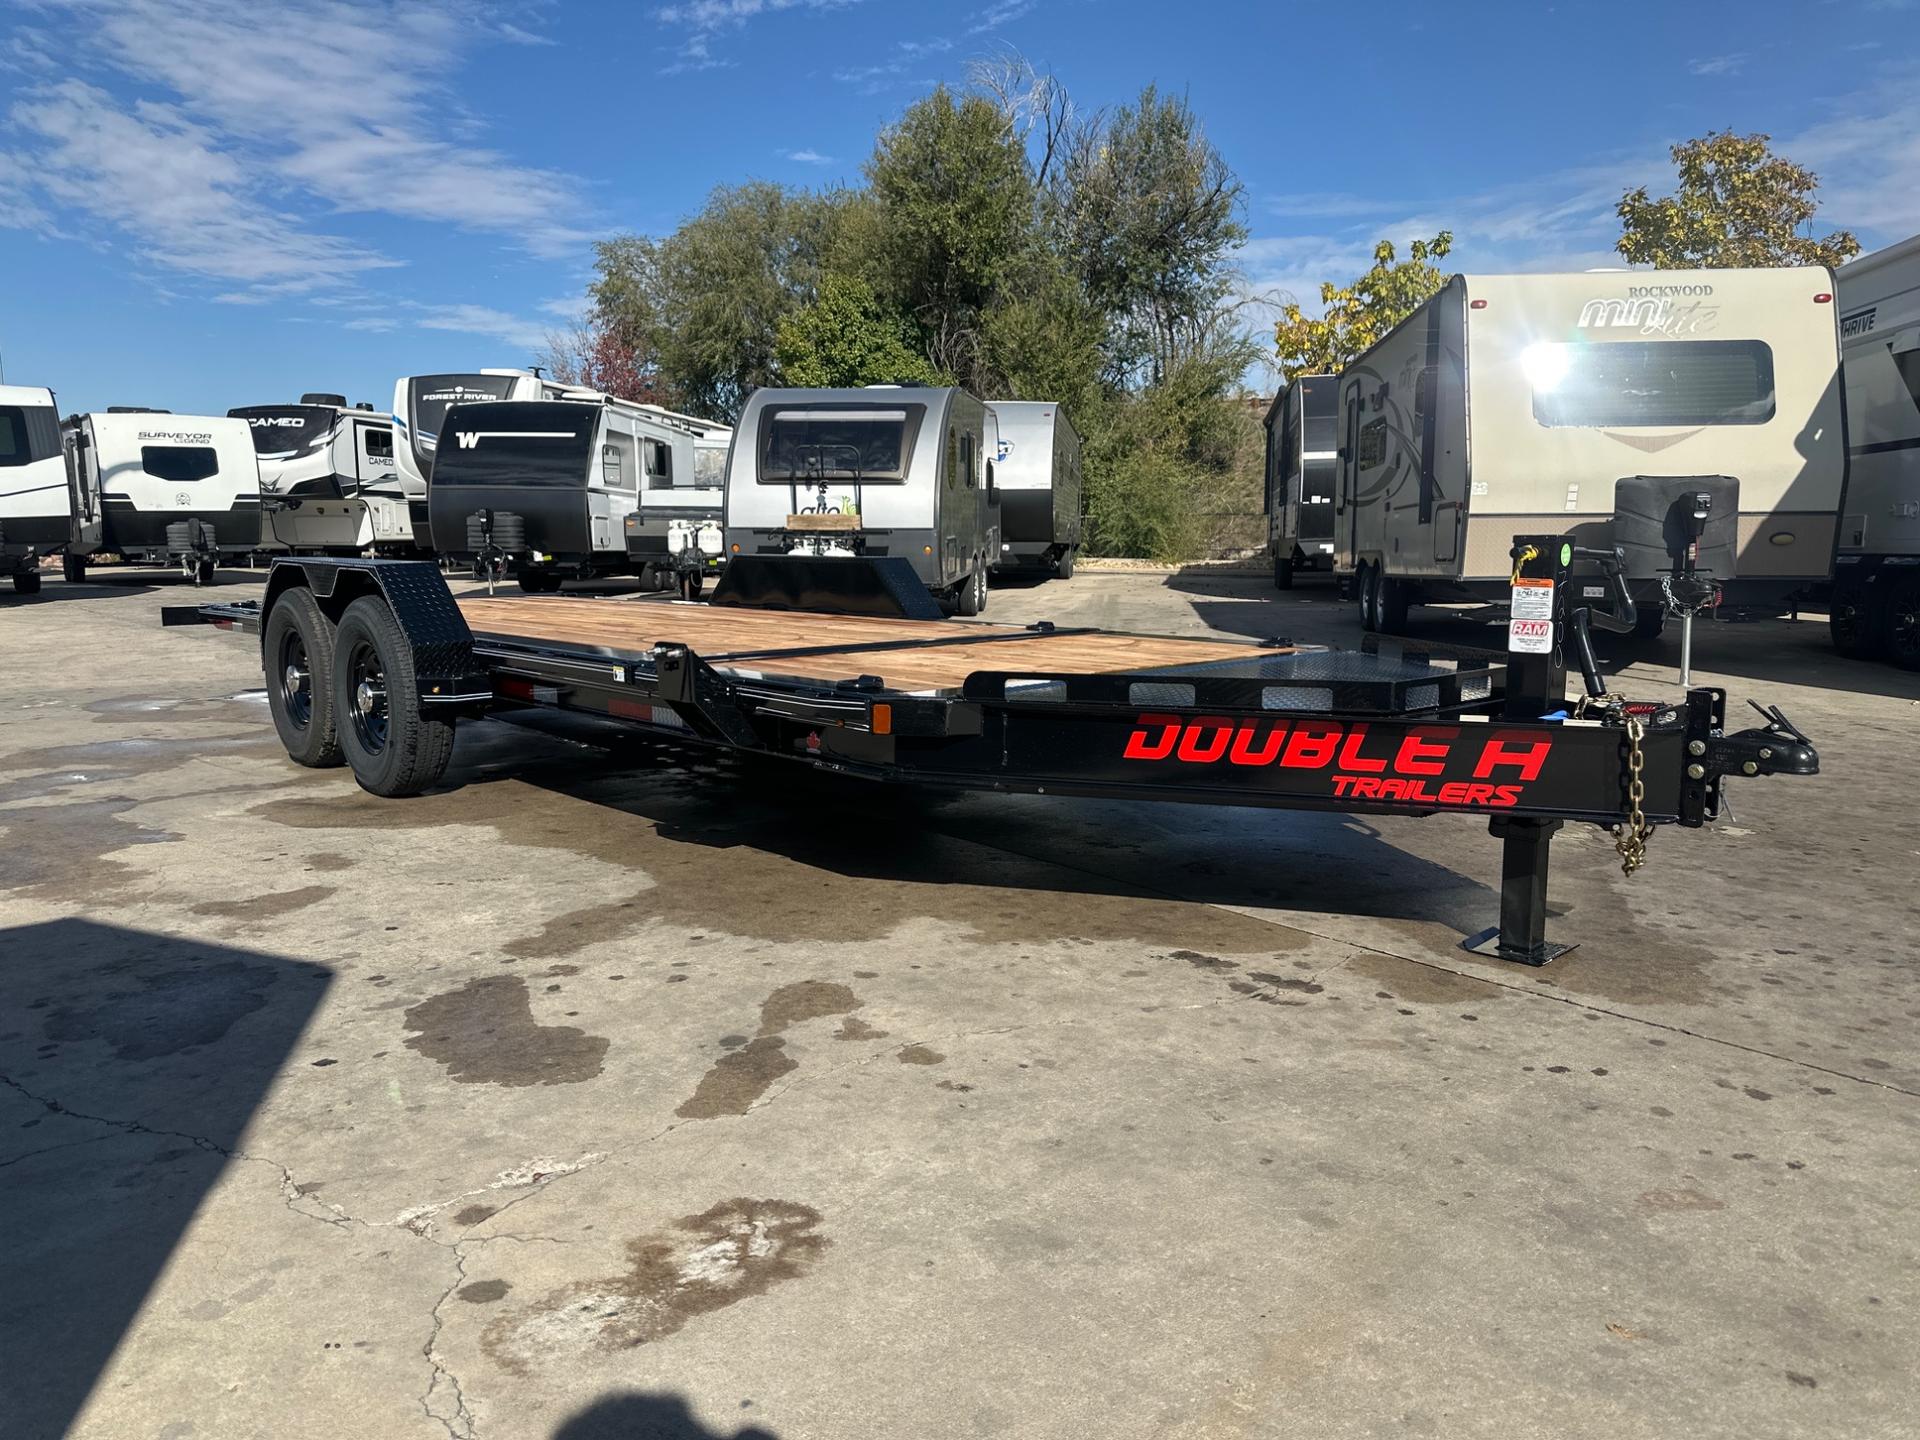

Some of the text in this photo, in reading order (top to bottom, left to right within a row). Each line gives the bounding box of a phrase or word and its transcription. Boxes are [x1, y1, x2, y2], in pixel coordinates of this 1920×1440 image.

[1629, 285, 1713, 297] ROCKWOOD
[1840, 307, 1877, 338] THRIVE
[423, 393, 462, 401] FOREST
[249, 418, 305, 427] CAMEO
[138, 431, 212, 439] SURVEYOR
[369, 457, 394, 466] CAMEO
[1512, 622, 1548, 636] RAM
[1123, 713, 1553, 780] DOUBLE A
[1330, 775, 1524, 806] TRAILERS
